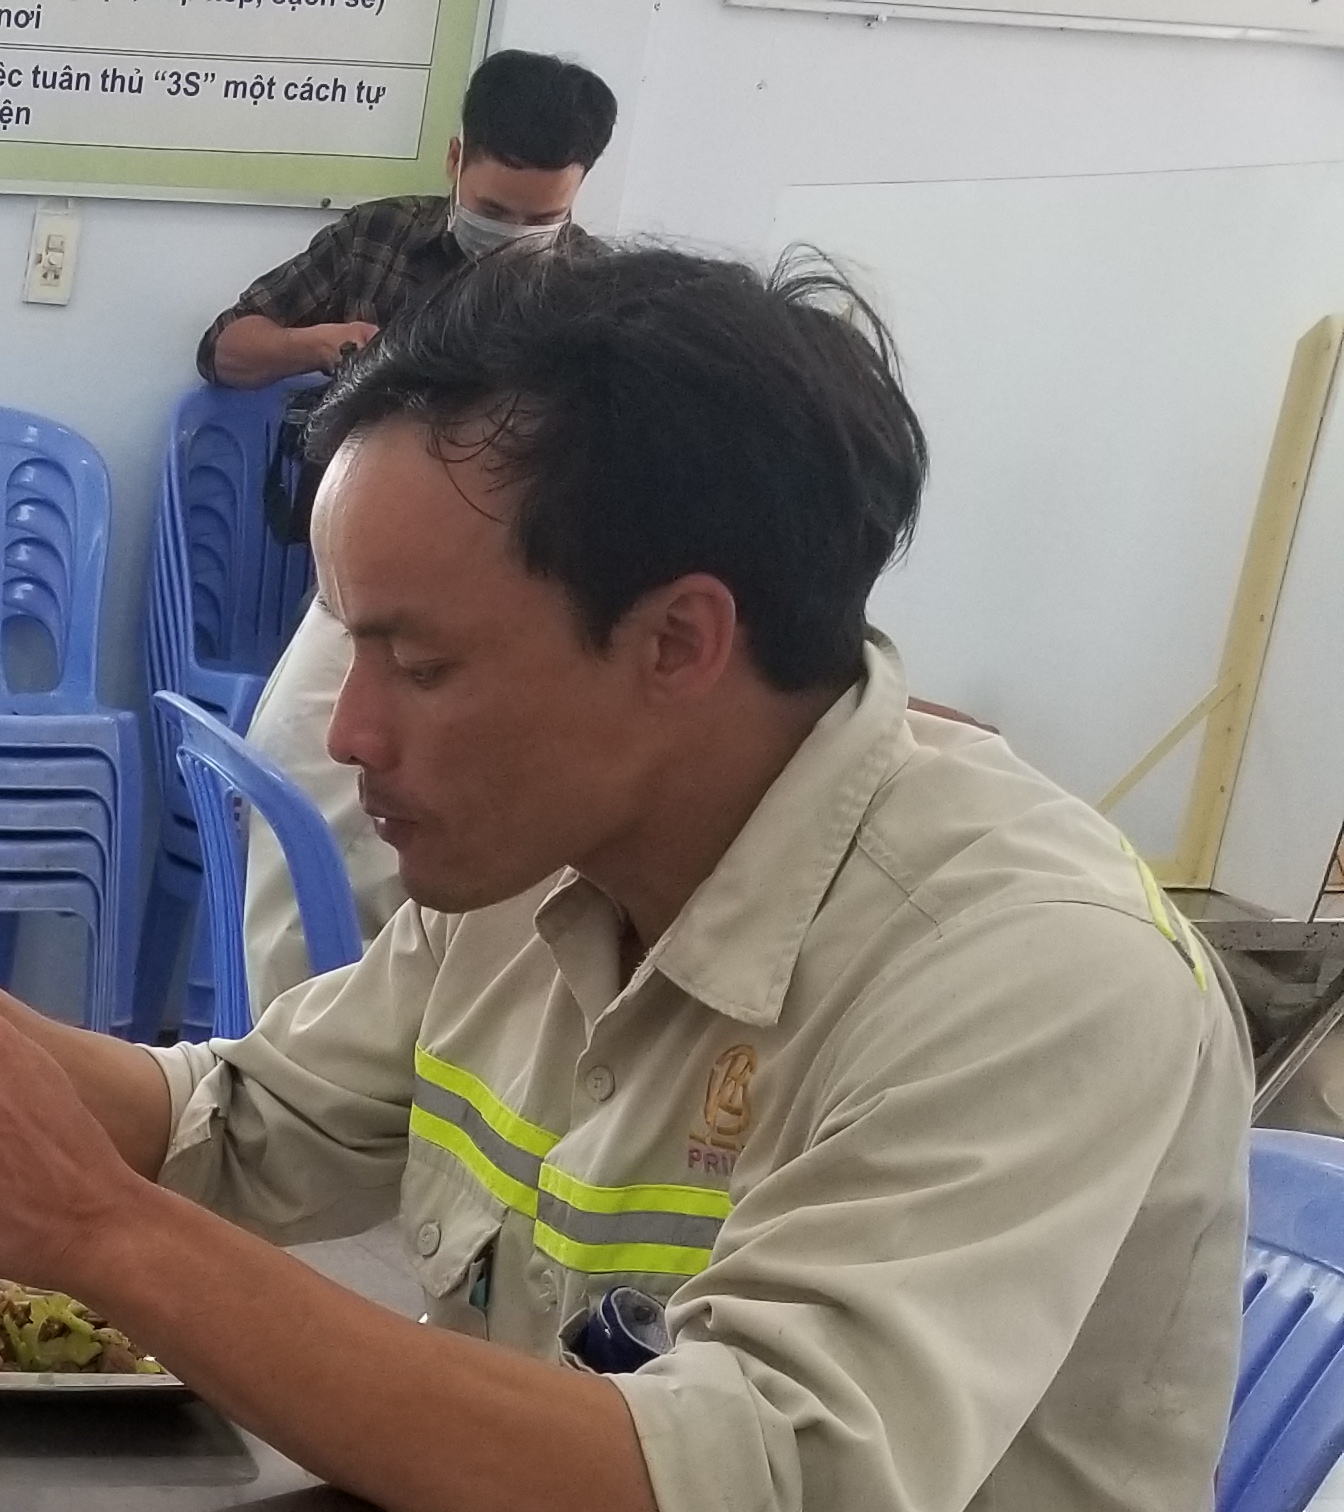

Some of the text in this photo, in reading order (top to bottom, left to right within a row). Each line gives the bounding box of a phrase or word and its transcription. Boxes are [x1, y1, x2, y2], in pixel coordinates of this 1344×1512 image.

[31, 64, 91, 92] tuân
[100, 67, 144, 95] thủ
[223, 74, 276, 106] một
[283, 75, 347, 103] cách
[356, 79, 387, 111] tự
